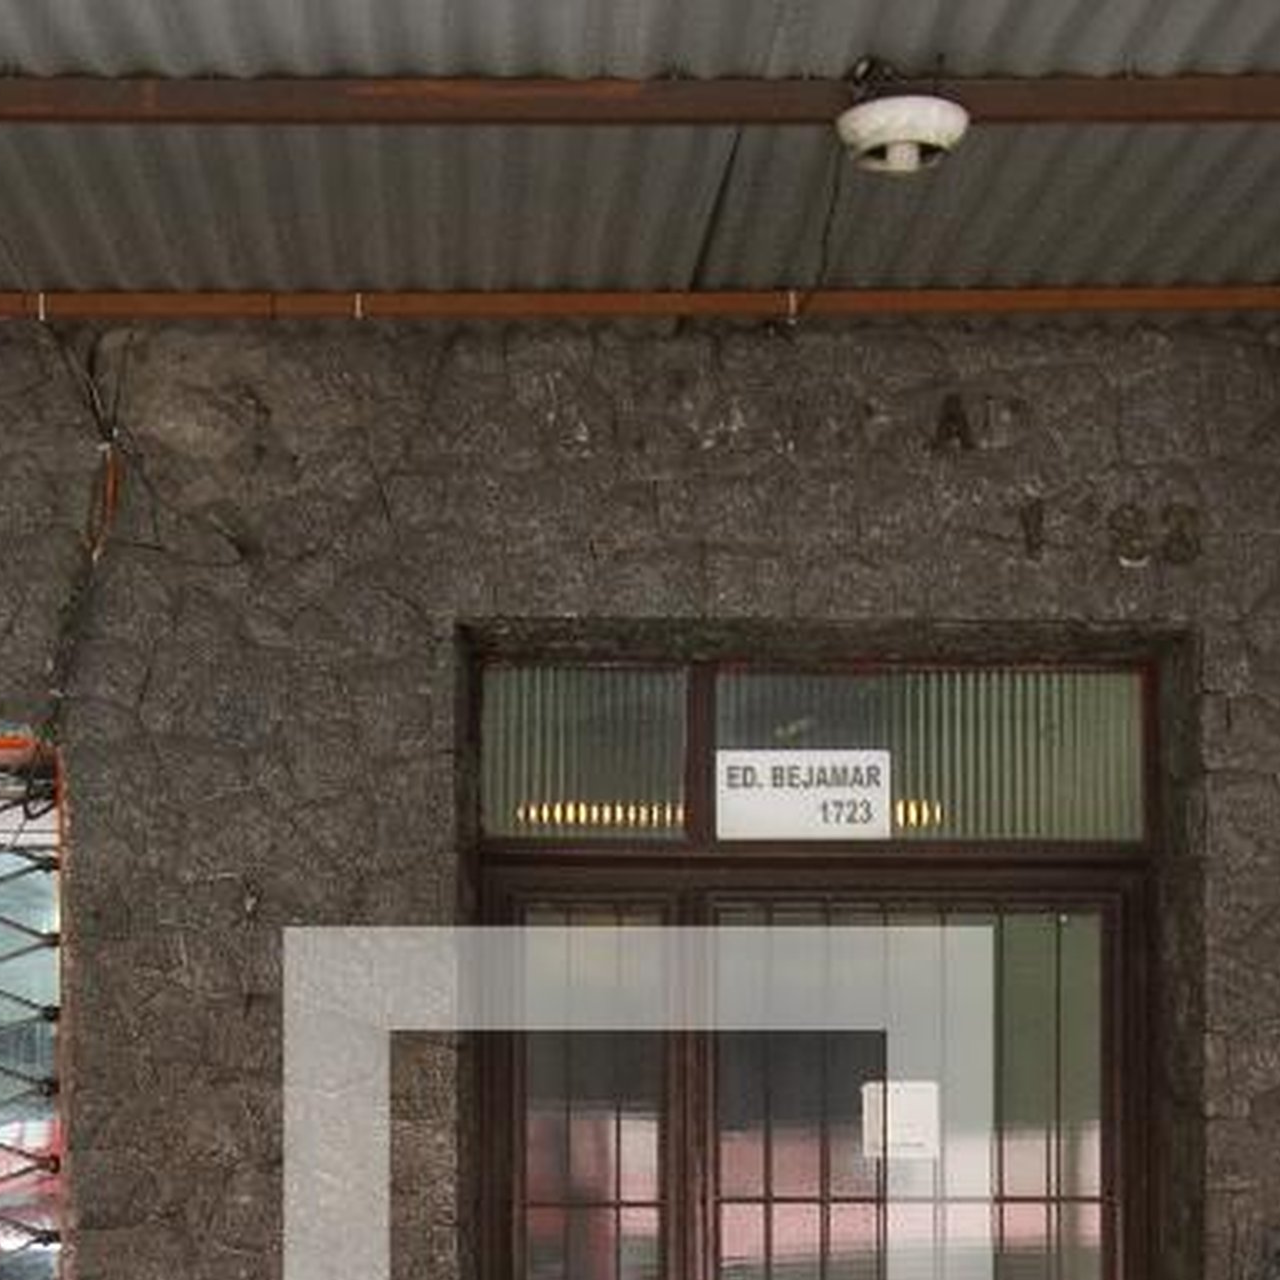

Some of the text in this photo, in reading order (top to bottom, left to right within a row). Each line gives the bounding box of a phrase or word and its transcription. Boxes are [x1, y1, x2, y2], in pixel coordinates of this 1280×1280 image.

[726, 765, 882, 788] ED. BEJAMAR
[821, 800, 874, 824] 1723
